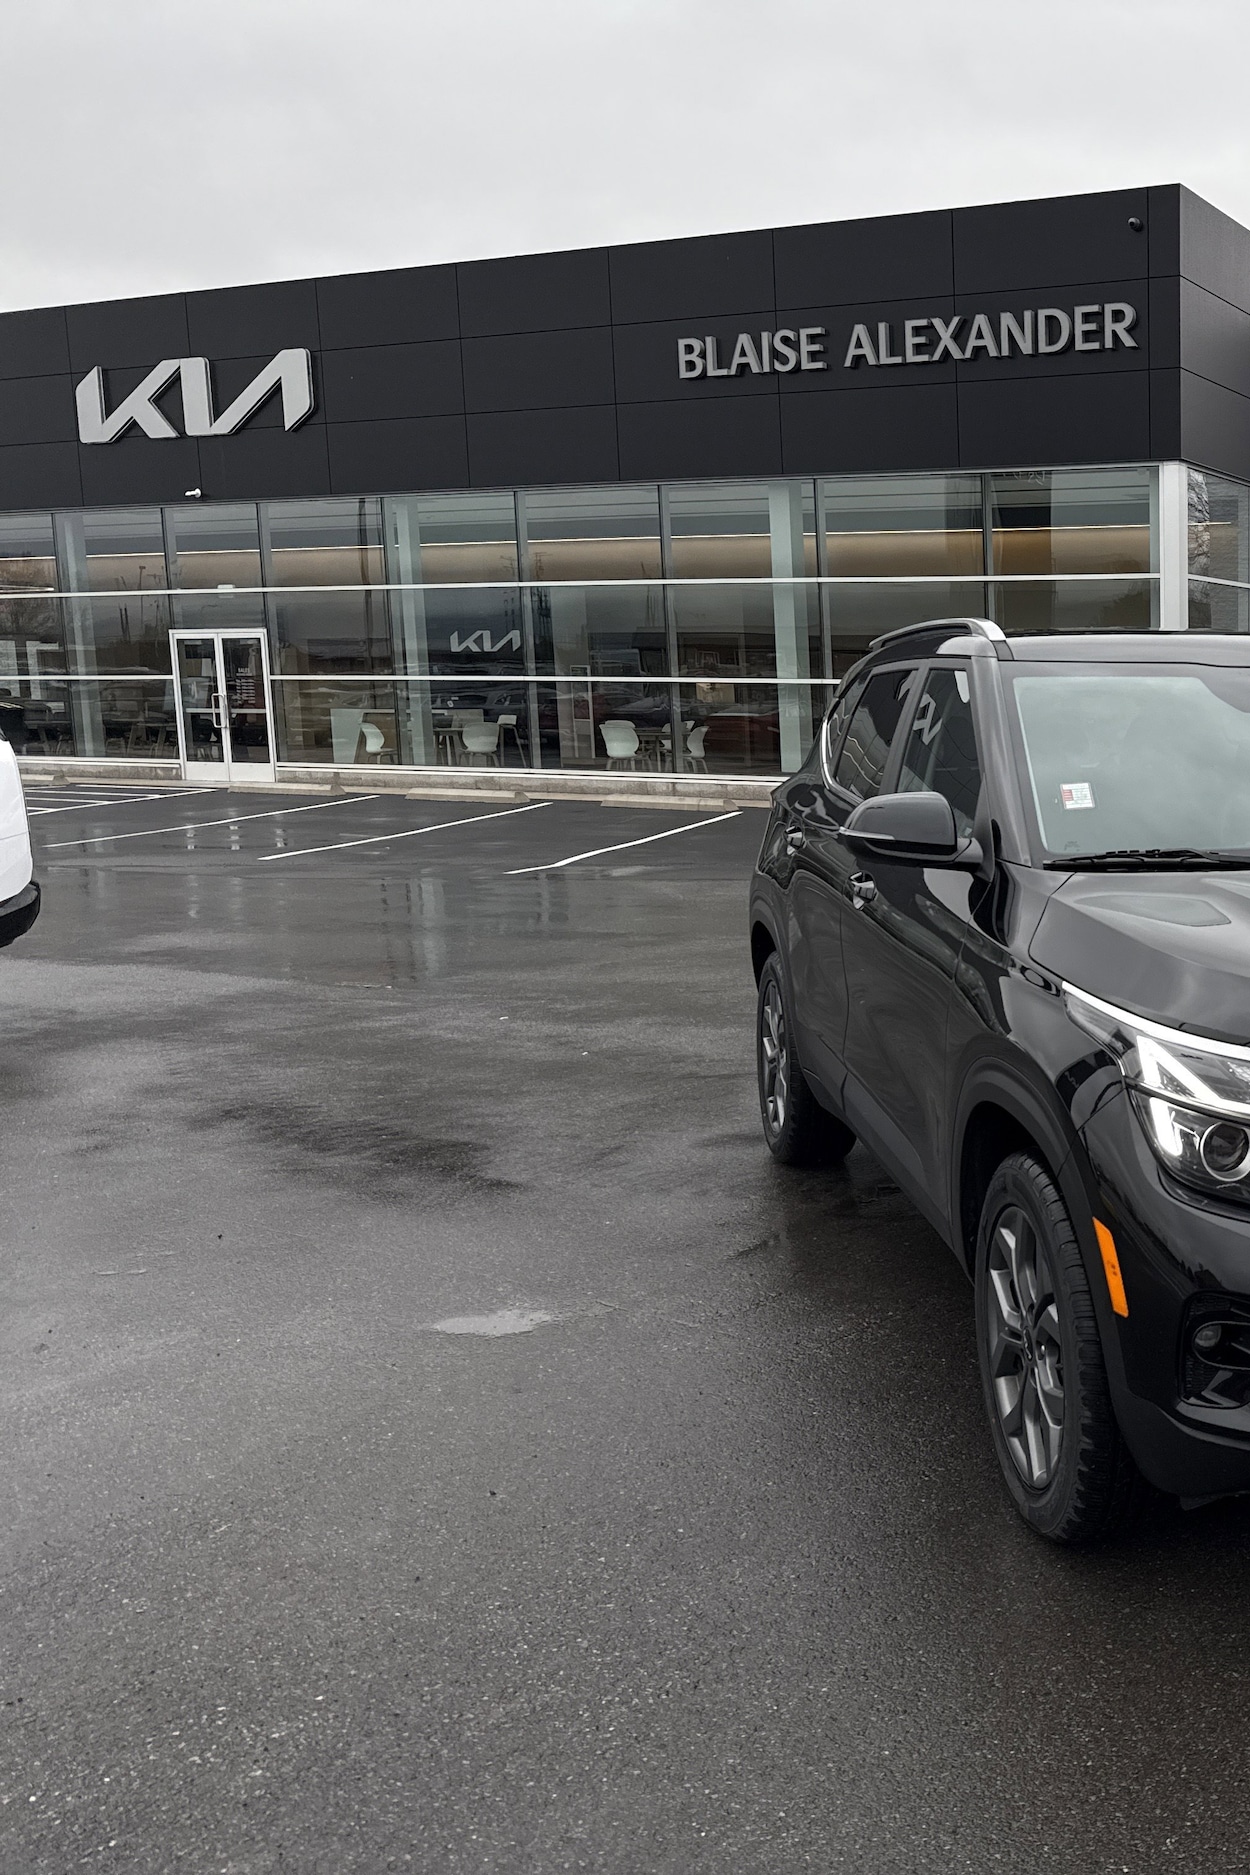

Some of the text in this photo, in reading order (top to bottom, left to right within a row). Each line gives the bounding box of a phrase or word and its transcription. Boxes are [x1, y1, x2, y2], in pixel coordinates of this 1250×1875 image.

[677, 302, 1139, 379] BLAISE ALEXANDER
[75, 347, 315, 444] KIA
[450, 629, 521, 653] KIA
